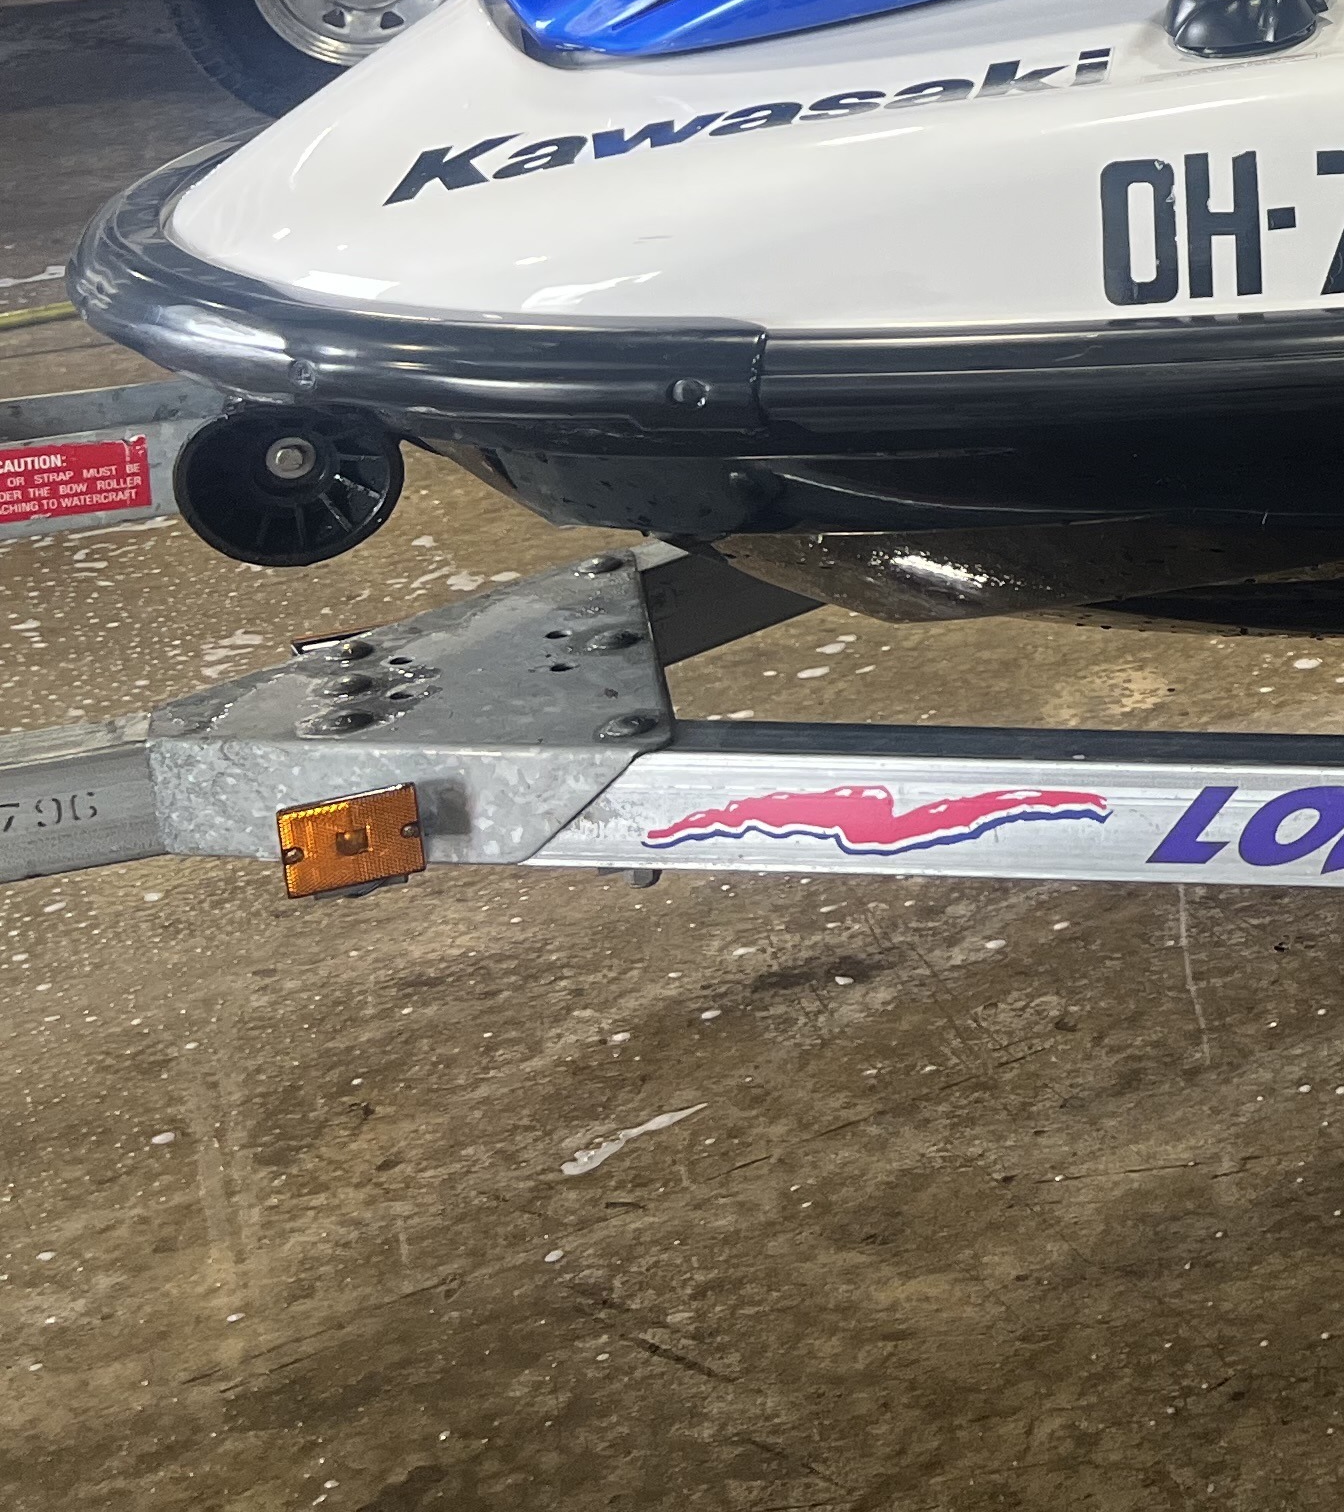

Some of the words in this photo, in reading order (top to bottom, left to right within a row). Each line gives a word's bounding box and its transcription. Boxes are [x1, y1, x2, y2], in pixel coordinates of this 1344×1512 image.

[382, 47, 1113, 206] Kawasaki
[7, 476, 25, 487] OR
[34, 471, 74, 484] STRAP
[83, 465, 117, 478] MUST
[126, 463, 141, 473] BE
[28, 486, 51, 497] THE
[60, 483, 88, 495] BOW
[97, 476, 142, 490] ROLLER
[42, 499, 58, 510] TO
[60, 489, 137, 508] WATERCRAFT
